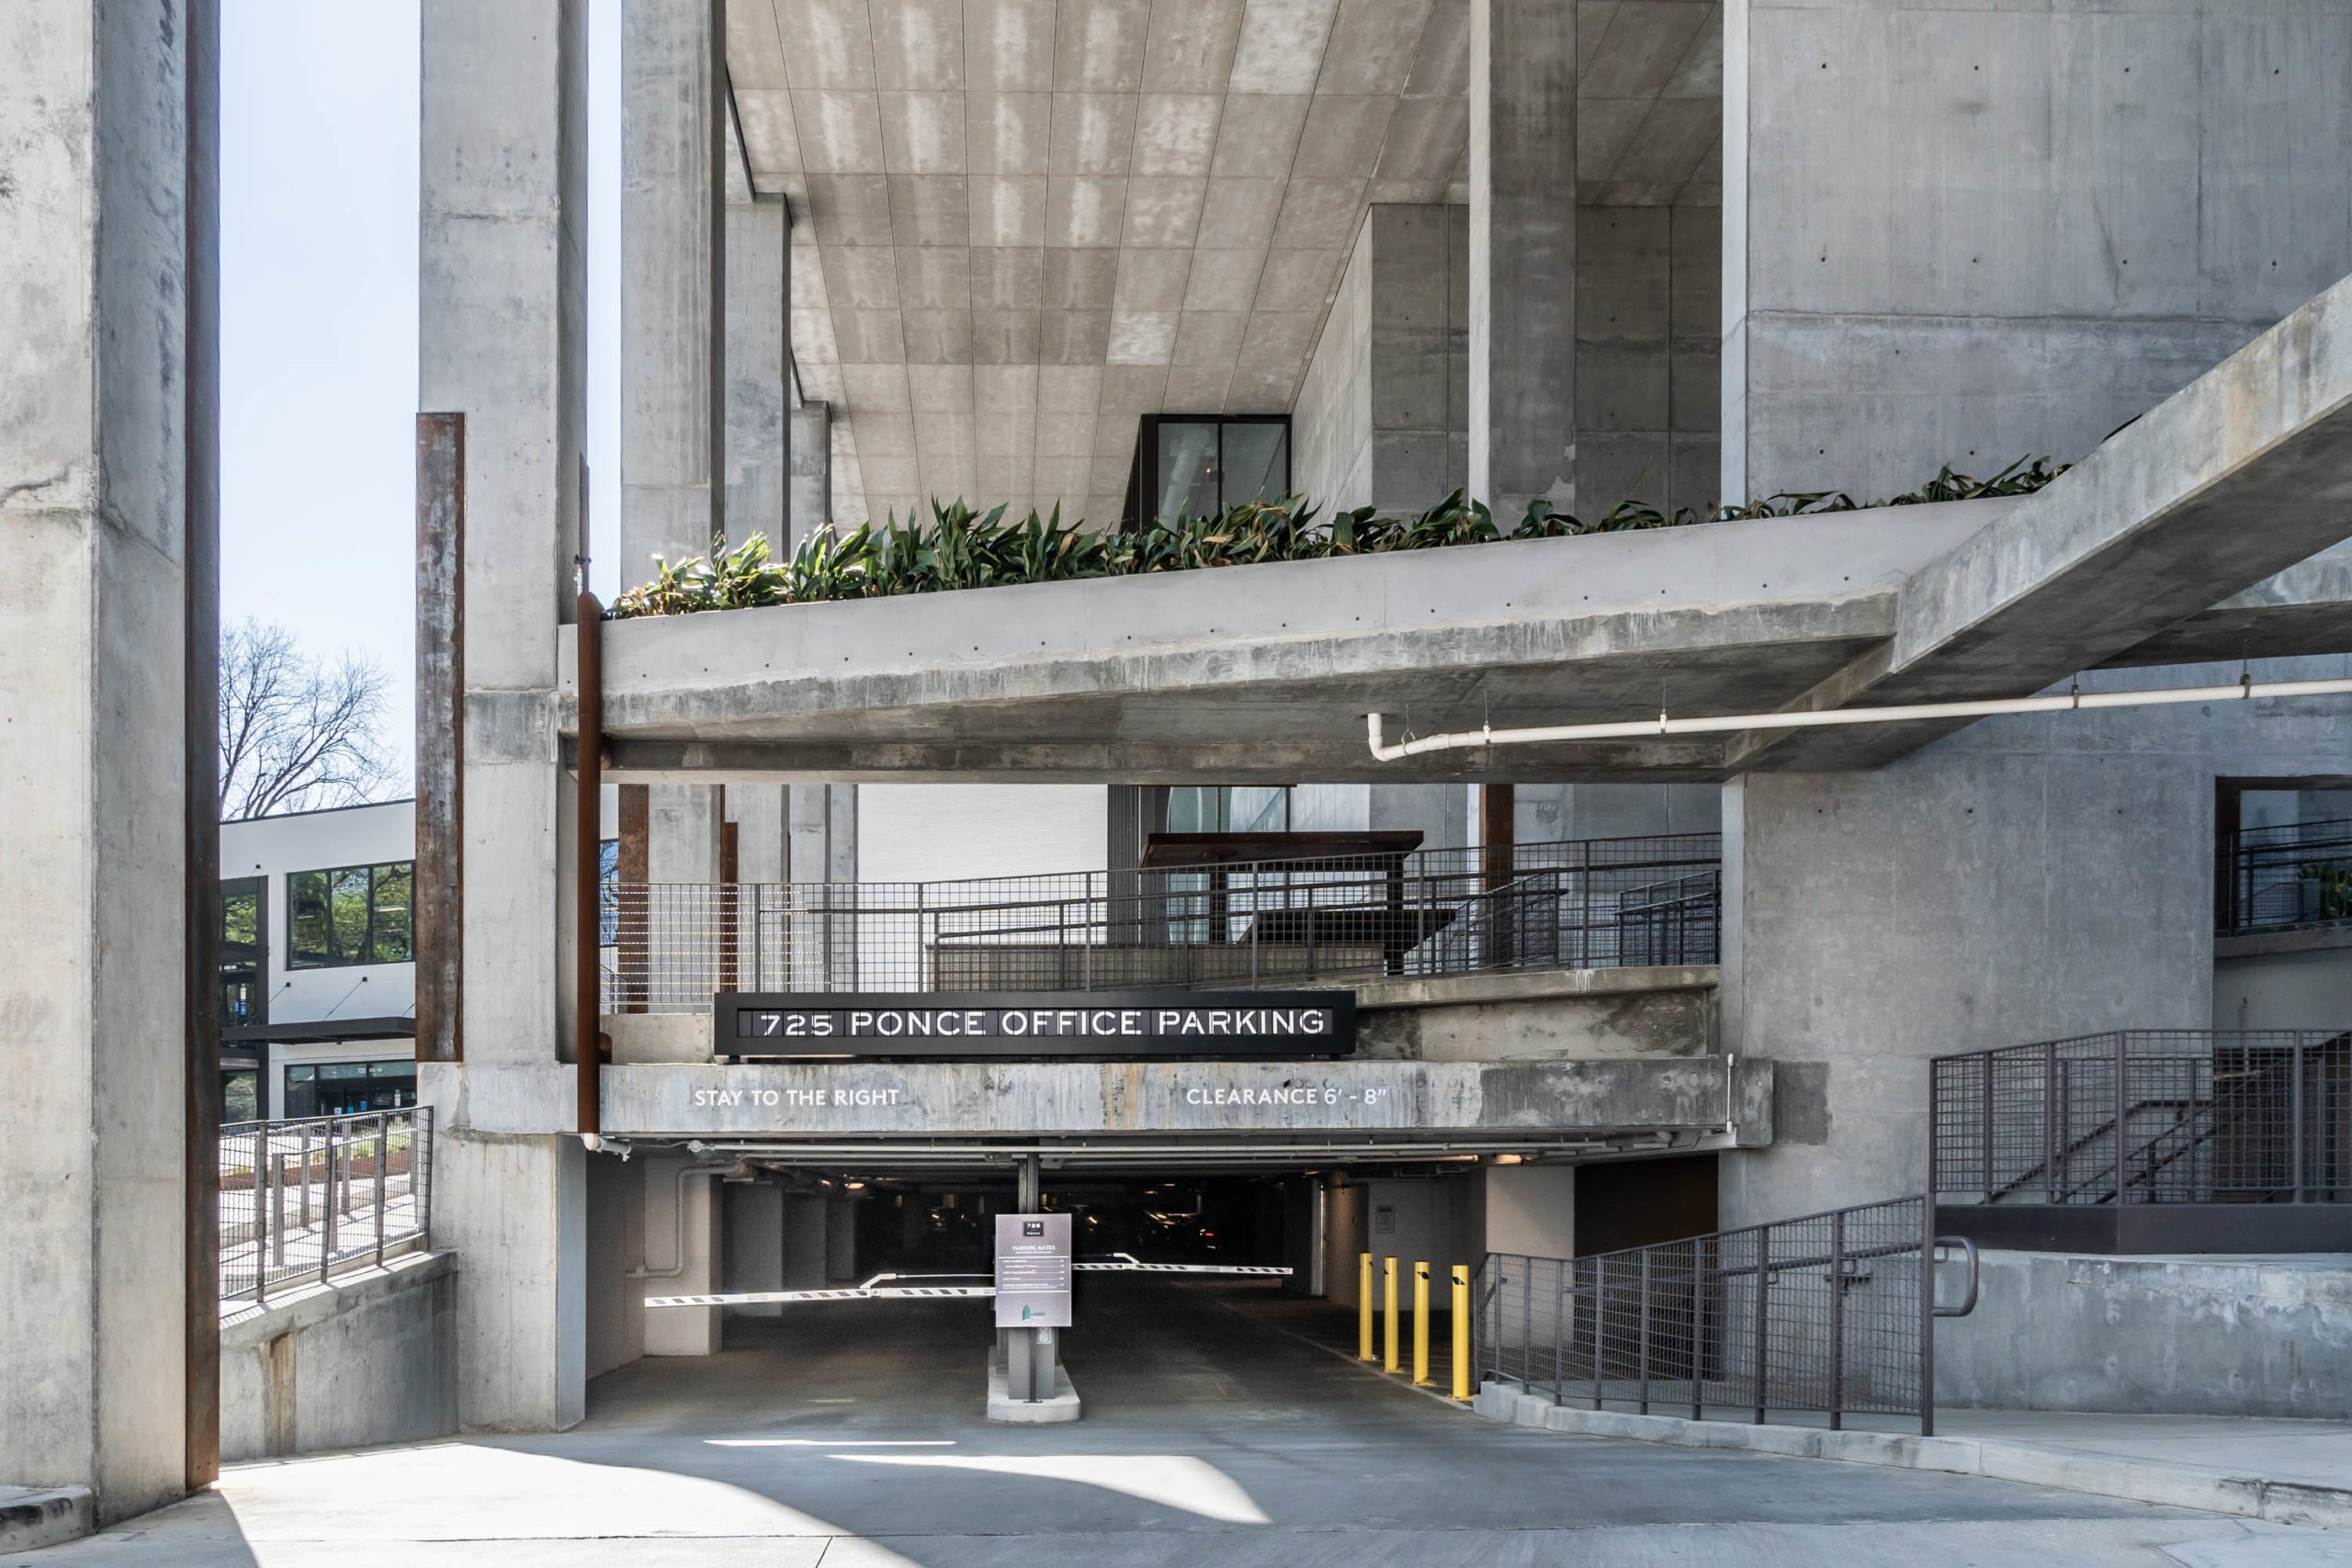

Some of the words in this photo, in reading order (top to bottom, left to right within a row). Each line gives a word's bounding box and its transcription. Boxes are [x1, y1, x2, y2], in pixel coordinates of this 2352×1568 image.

[761, 1014, 833, 1036] 725
[851, 1010, 987, 1036] PONCE
[1001, 1010, 1142, 1036] OFFICE
[1159, 1010, 1325, 1035] PARKING
[694, 1089, 743, 1106] STAY
[751, 1089, 779, 1106] TO
[786, 1089, 826, 1106] THE
[834, 1089, 899, 1106] RIGHT
[1186, 1088, 1317, 1105] CLEARANCE
